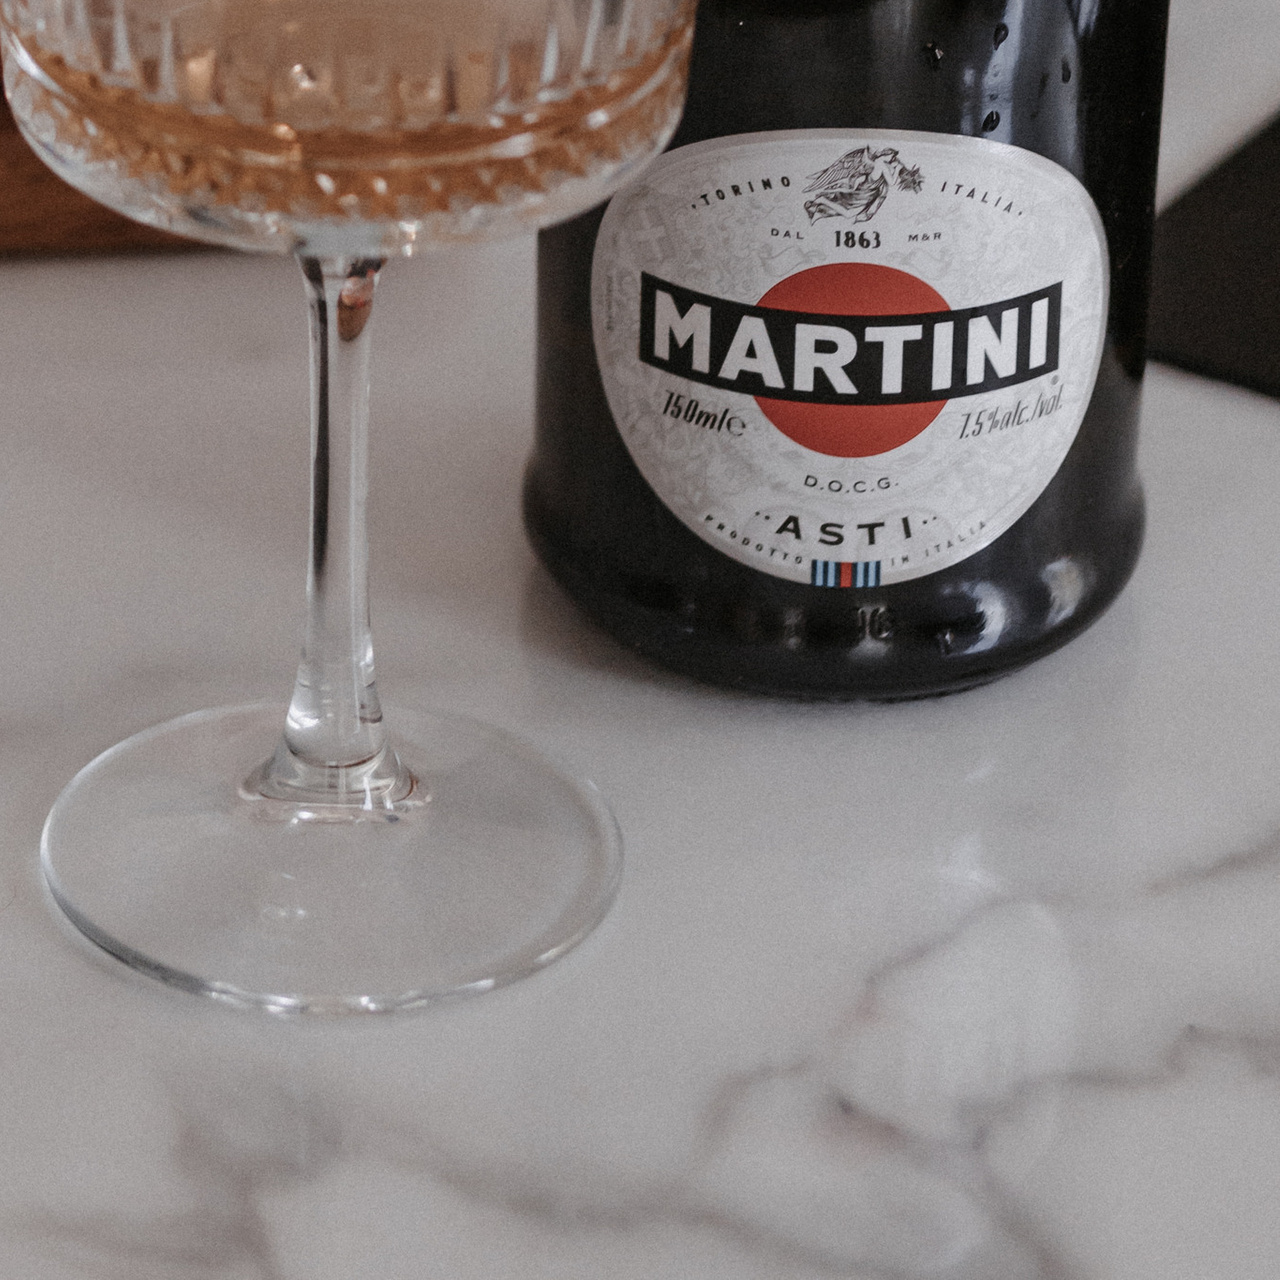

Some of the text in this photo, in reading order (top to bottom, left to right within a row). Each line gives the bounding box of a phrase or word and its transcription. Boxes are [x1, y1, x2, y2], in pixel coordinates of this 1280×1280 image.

[701, 176, 1014, 214] TORINO ITALIA
[771, 228, 942, 249] DAL 1863 M&R
[653, 288, 1049, 395] MARTINI
[804, 474, 899, 494] D.O.C.G.
[775, 515, 912, 546] ASTI
